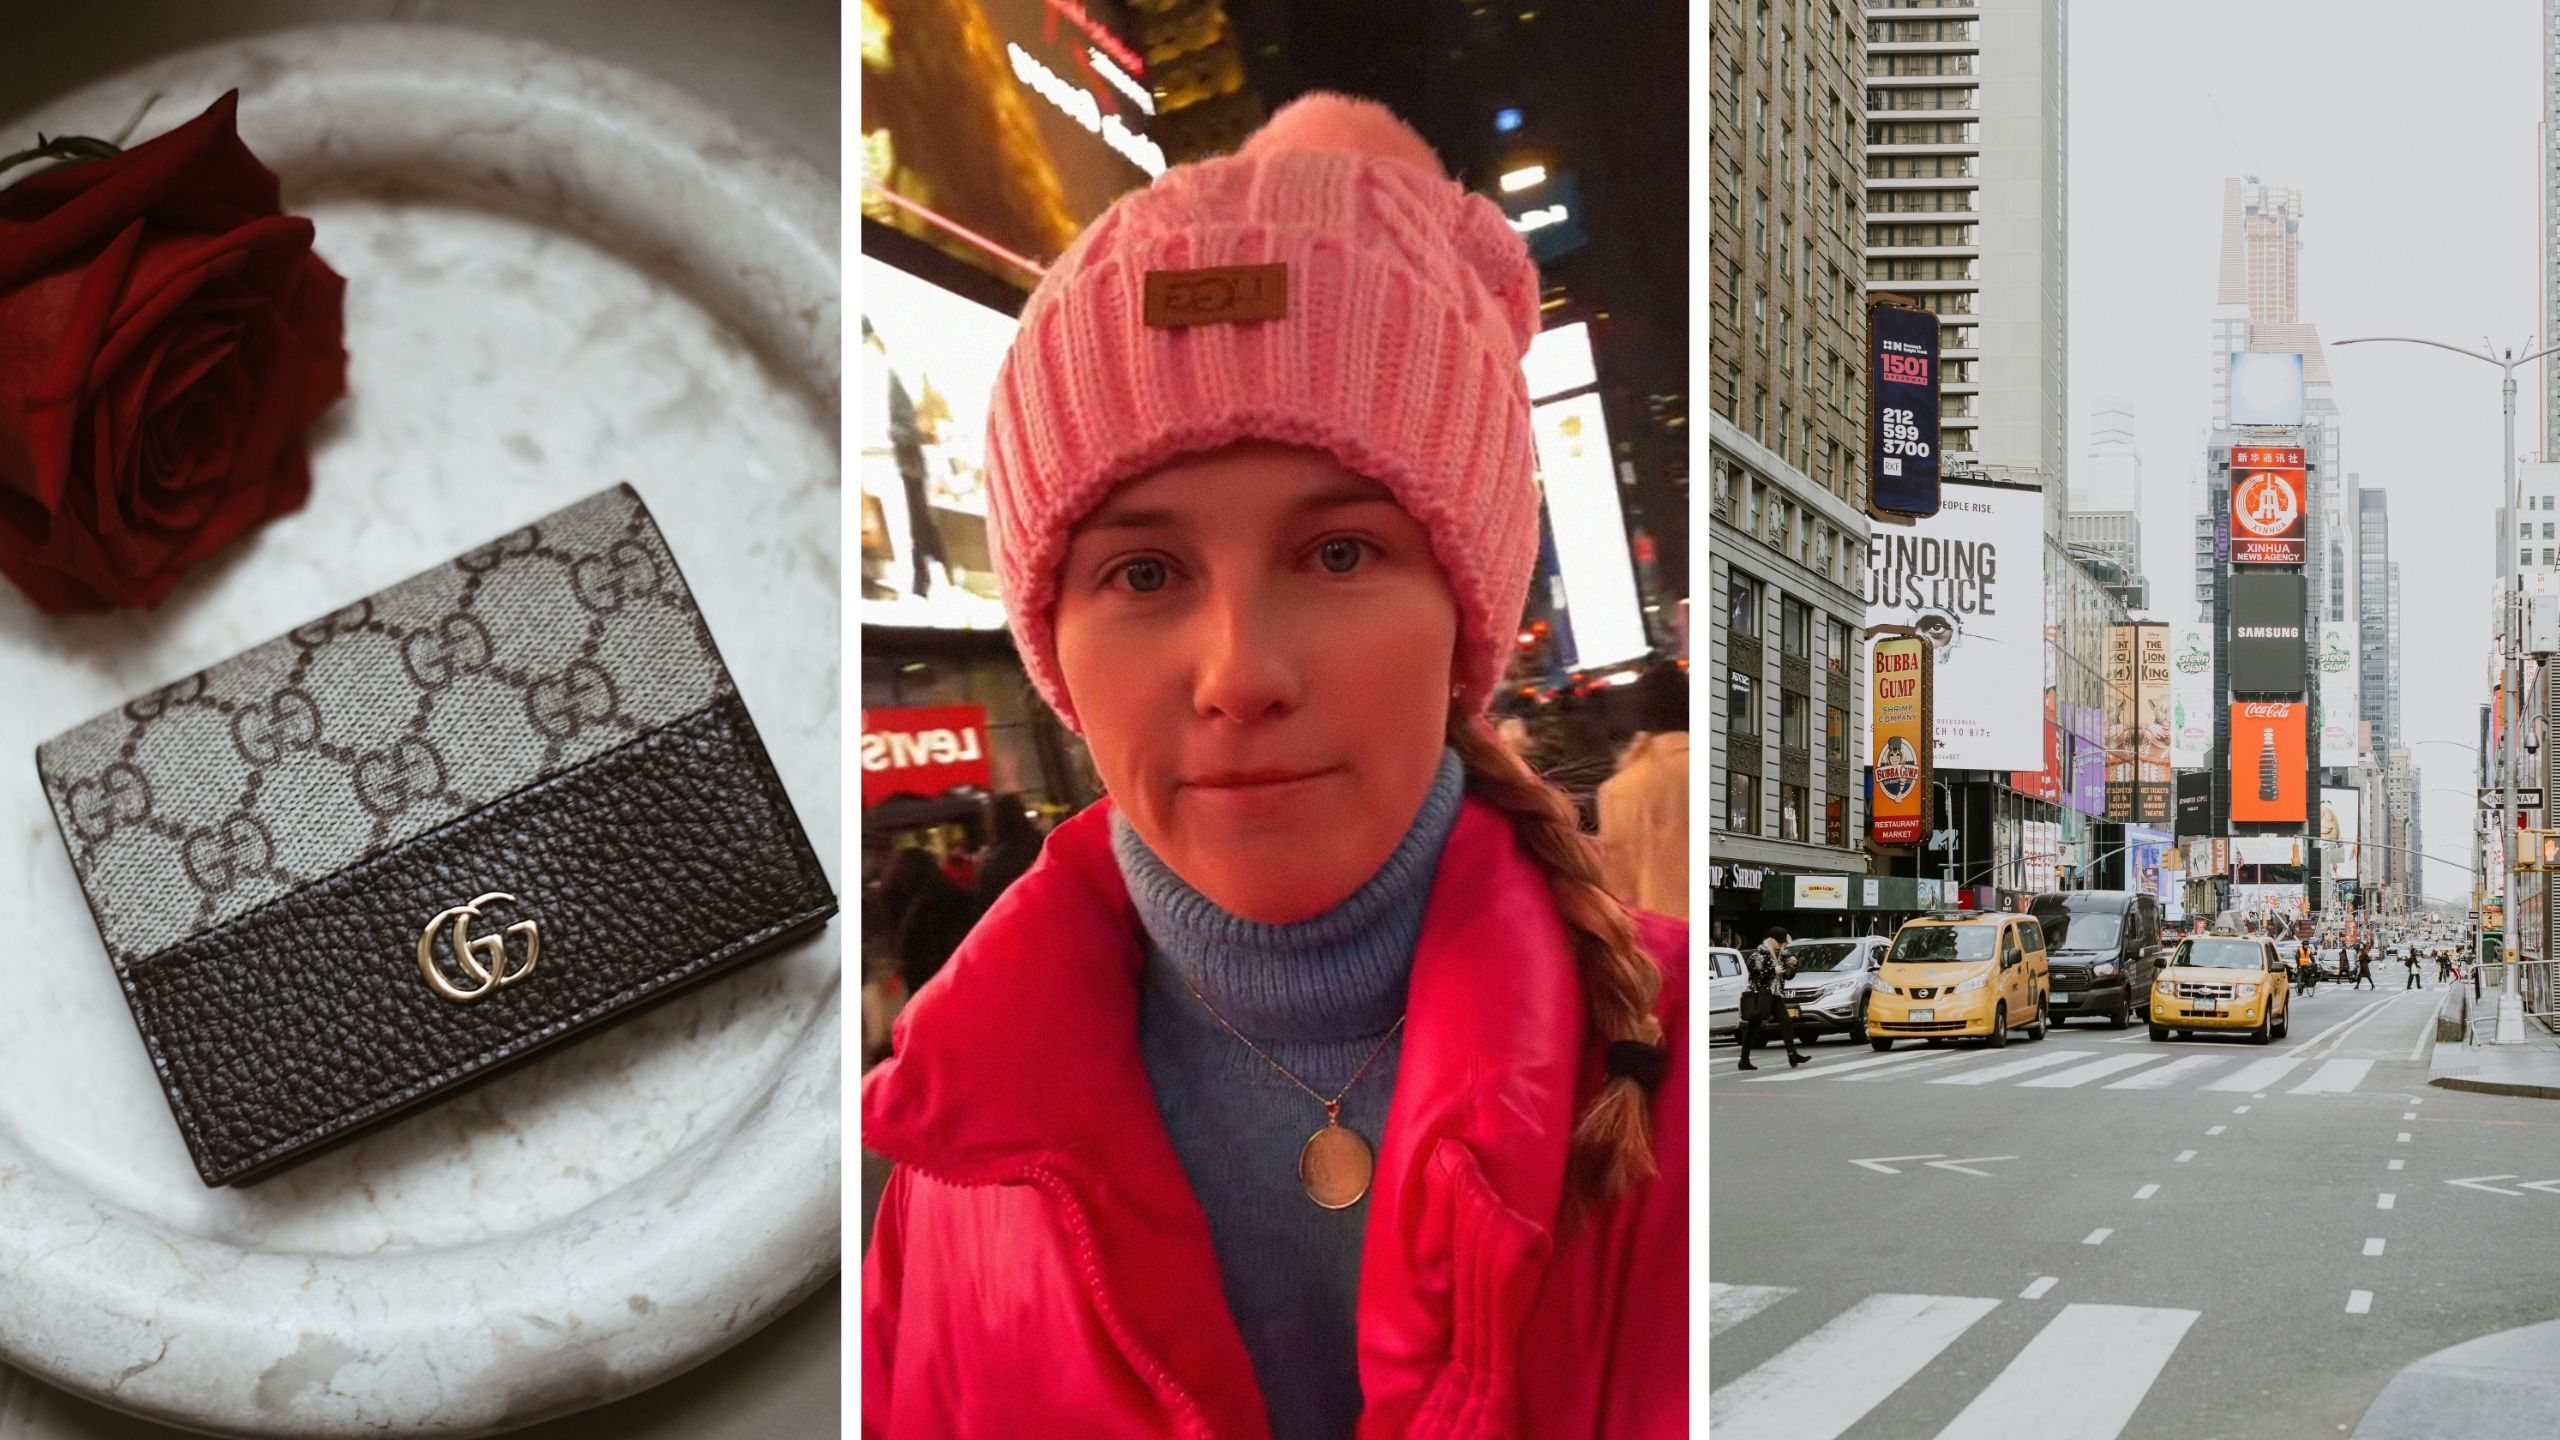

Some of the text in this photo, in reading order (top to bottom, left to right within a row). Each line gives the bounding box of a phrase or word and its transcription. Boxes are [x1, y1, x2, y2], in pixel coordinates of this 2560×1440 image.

[1880, 353, 1928, 377] 1501
[1885, 373, 1926, 384] BROADWAY
[1883, 408, 1914, 425] 212
[1883, 424, 1919, 441] 599
[1883, 439, 1930, 457] 3700
[2237, 453, 2298, 464] 新华通讯社
[1942, 500, 1995, 514] EOPLE RISE.
[2251, 522, 2287, 534] XINHUA
[2247, 543, 2290, 553] XINHUA
[1867, 533, 1996, 580] FINDING
[2237, 553, 2300, 561] NEWS AGENCY
[1866, 567, 1996, 616] JUSTICE
[2237, 626, 2299, 638] SAMSUNG
[2145, 640, 2162, 648] THE
[1875, 652, 1919, 673] BUBBA
[2142, 650, 2166, 664] LION
[2179, 655, 2211, 664] Green
[2141, 665, 2169, 681] KING
[2181, 663, 2213, 674] Giant
[2320, 662, 2351, 673] Giant
[1879, 678, 1916, 699] GUMP
[1882, 705, 1913, 713] SHRIMP
[2244, 702, 2291, 719] Coca-Cola
[1878, 714, 1917, 723] COMPANY
[1952, 727, 1964, 737] 10
[1969, 728, 1991, 738] 8/7c
[1877, 765, 1918, 781] BUBBA GUMP
[2487, 794, 2535, 804] ONE WAY
[1875, 819, 1919, 828] RESTAURANT
[1732, 863, 1763, 889] SHRIMP
